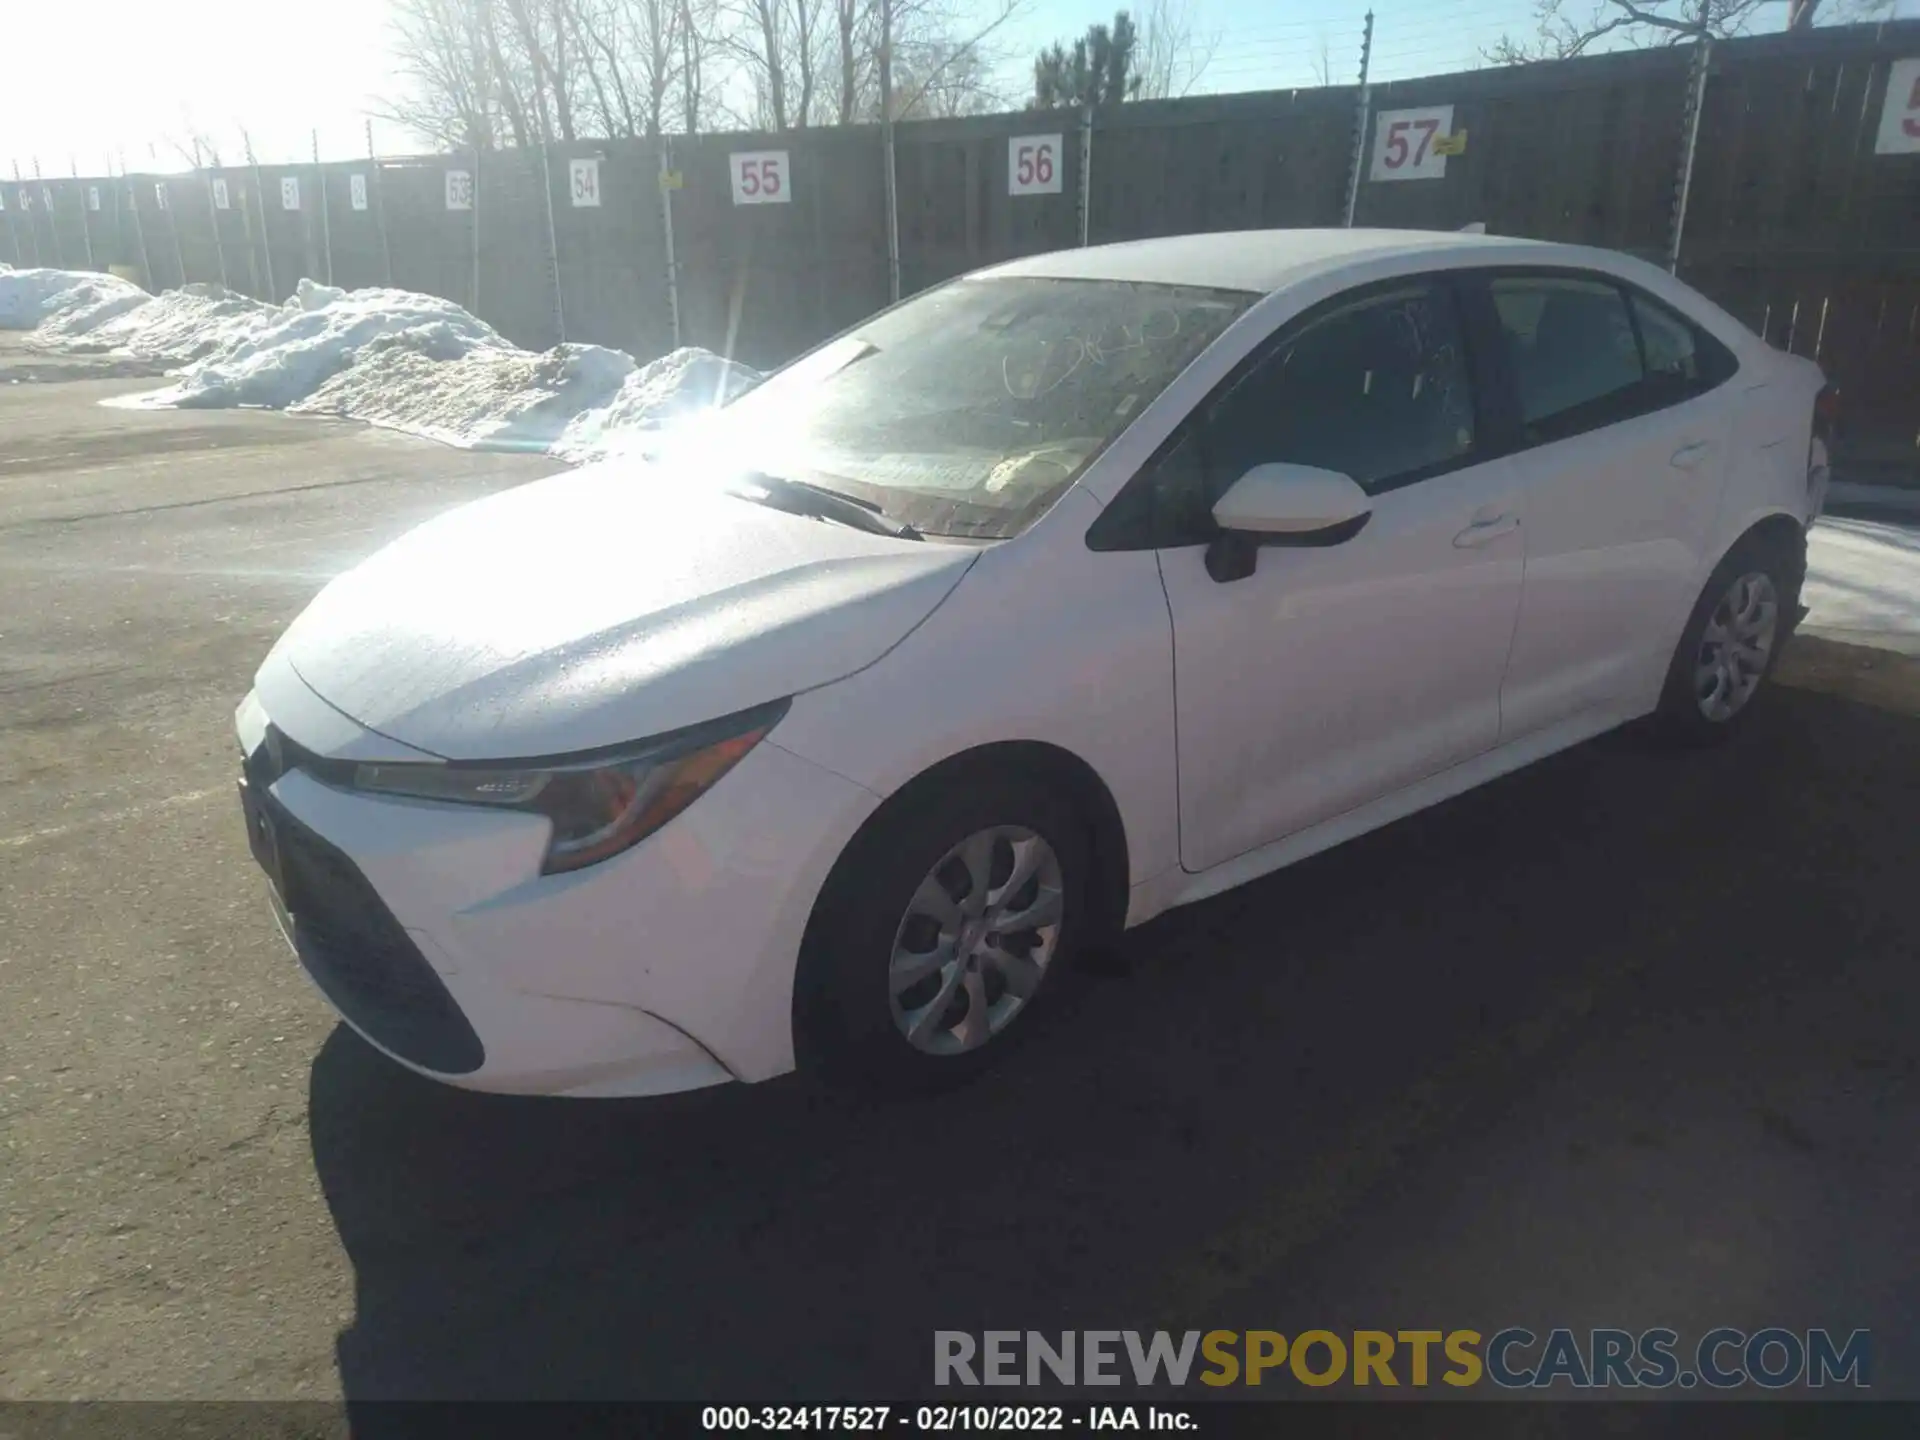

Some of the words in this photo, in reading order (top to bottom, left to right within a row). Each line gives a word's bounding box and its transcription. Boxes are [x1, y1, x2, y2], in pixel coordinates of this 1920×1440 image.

[1385, 119, 1440, 169] 57
[575, 168, 595, 199] 54
[741, 160, 781, 195] 55
[1018, 144, 1053, 185] 56
